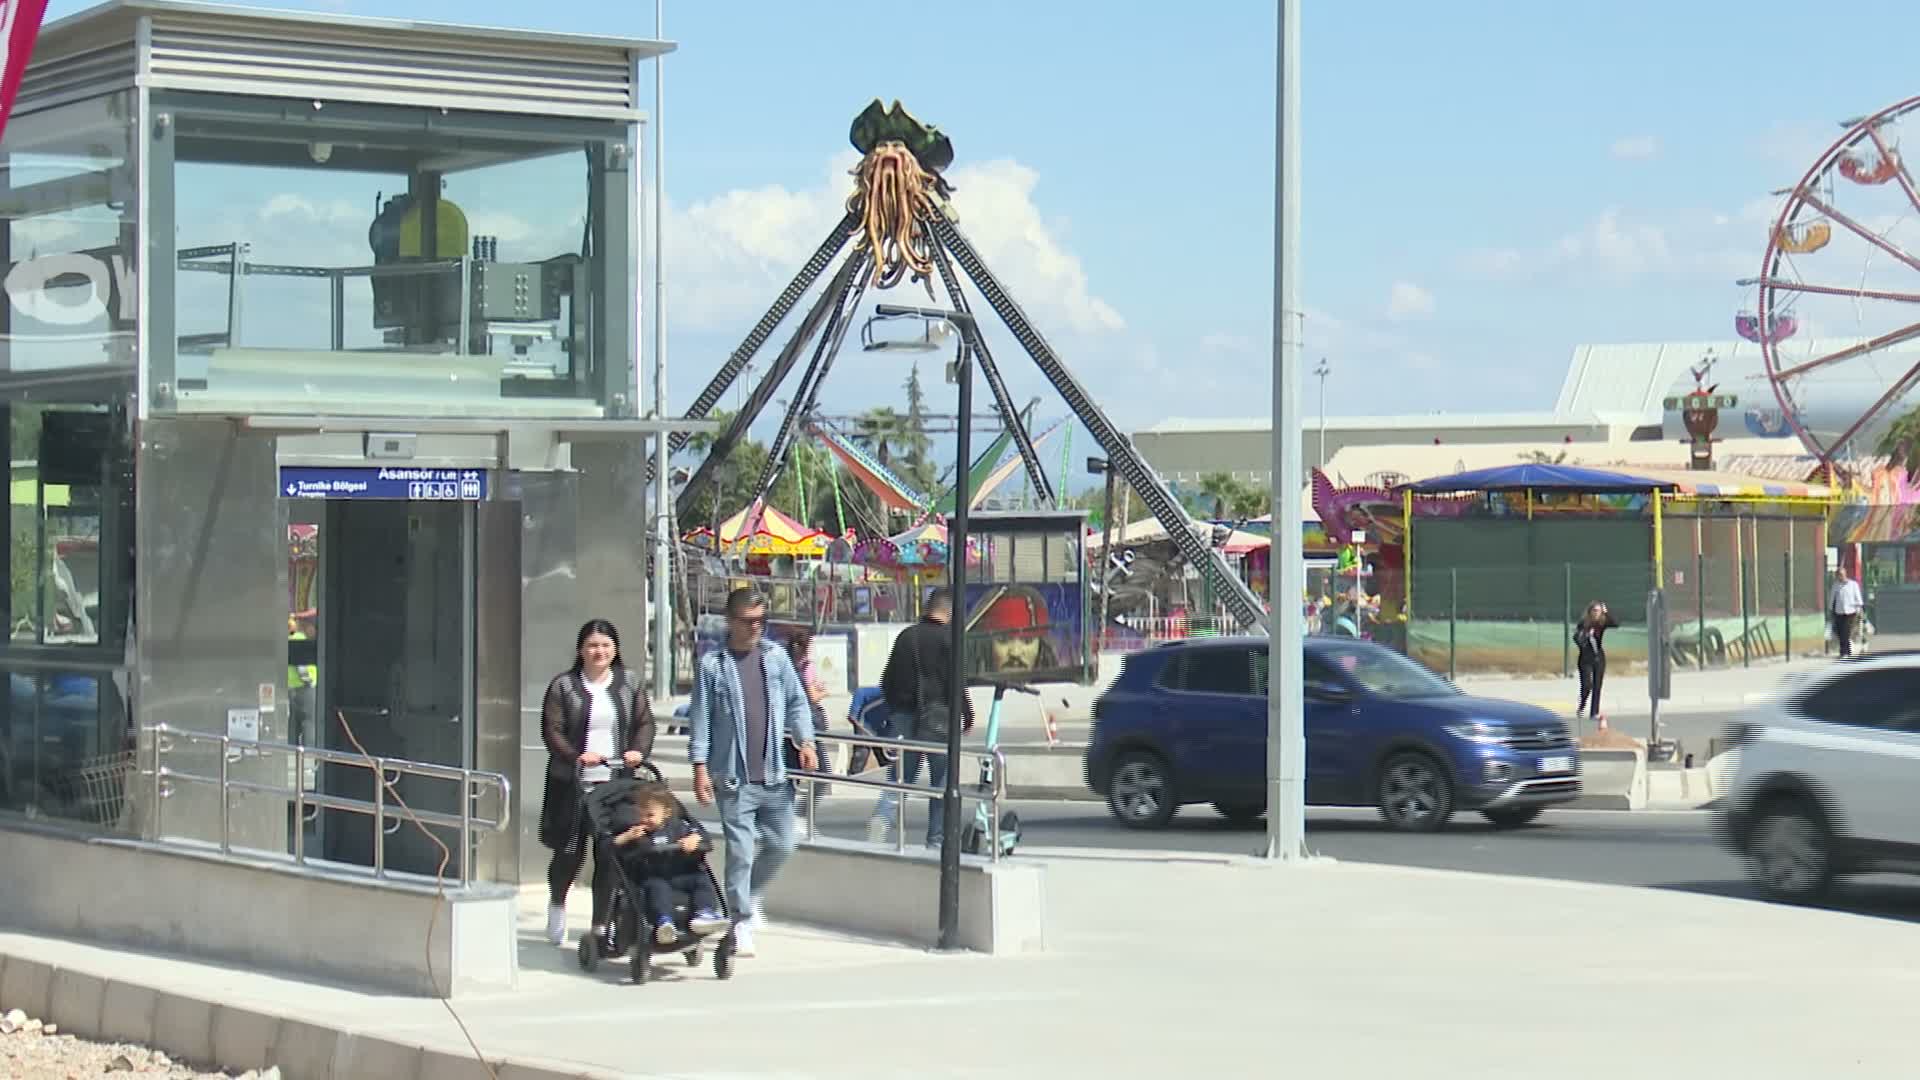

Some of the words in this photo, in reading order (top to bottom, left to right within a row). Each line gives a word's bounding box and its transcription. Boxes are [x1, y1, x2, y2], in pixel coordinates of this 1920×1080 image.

[378, 467, 433, 480] Asansör
[298, 481, 332, 491] Turnike
[333, 481, 367, 493] Bölgesi
